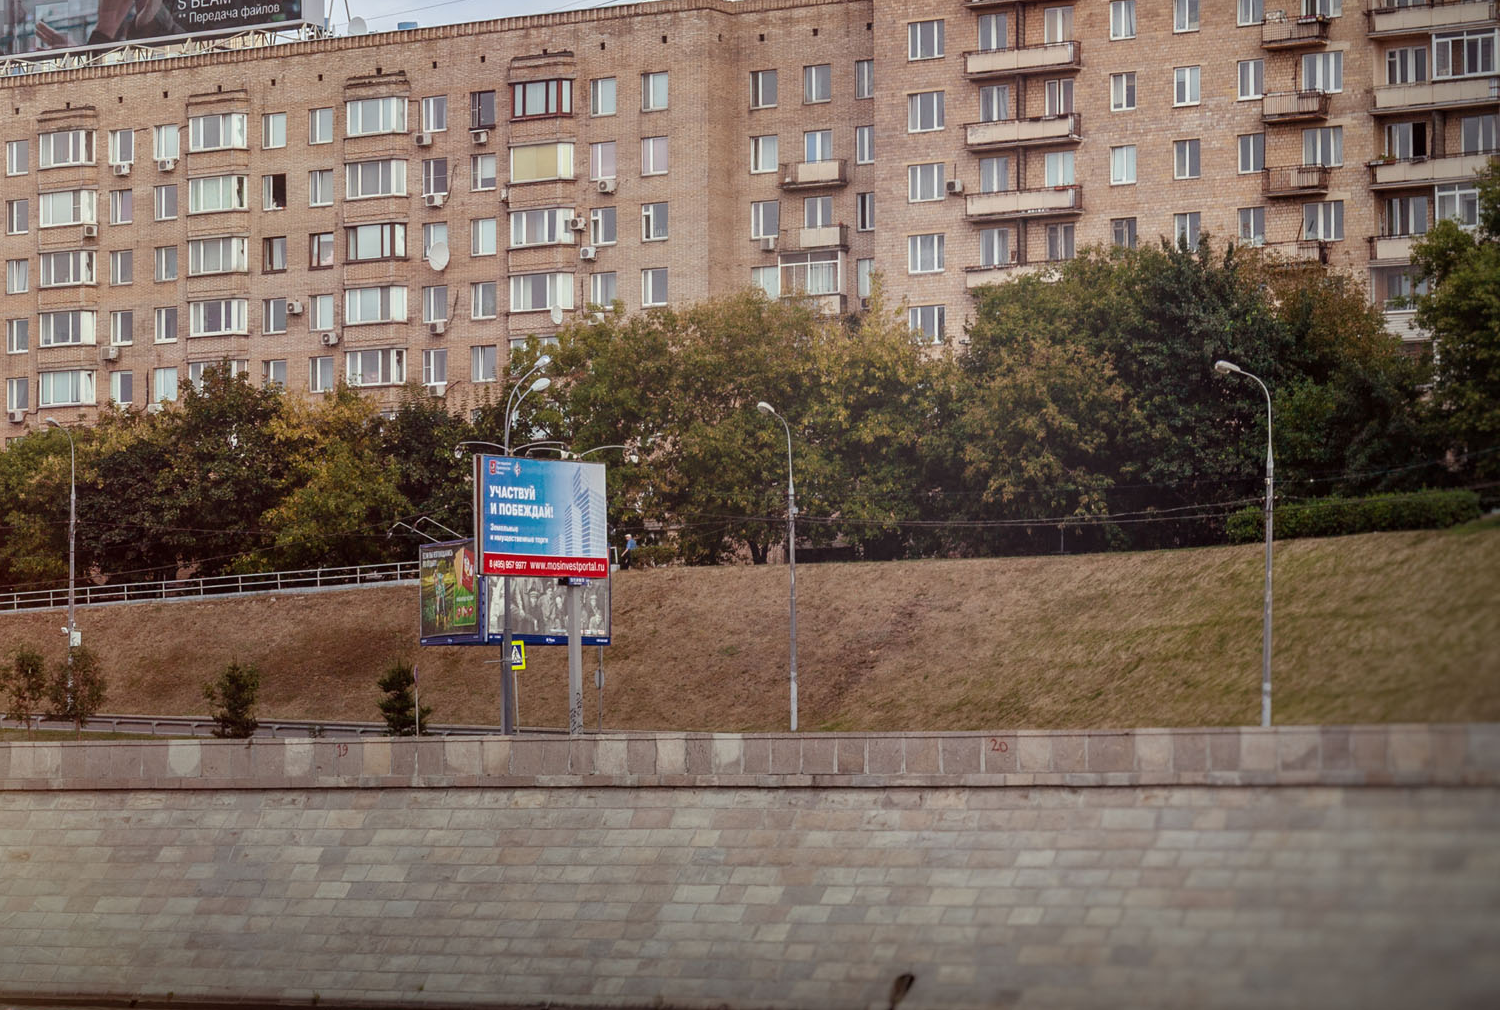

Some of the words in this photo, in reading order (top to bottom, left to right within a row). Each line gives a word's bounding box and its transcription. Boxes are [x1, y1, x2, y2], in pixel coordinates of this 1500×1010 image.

[189, 9, 238, 25] Передача
[240, 3, 280, 19] файлов
[489, 485, 536, 501] УЧАСТВУЙ
[490, 502, 497, 515] И
[499, 502, 554, 519] ПОБЕЖДАЙ!
[529, 561, 605, 574] www.mosinvestportal.ru
[336, 743, 349, 758] 19
[990, 738, 1009, 753] 20
